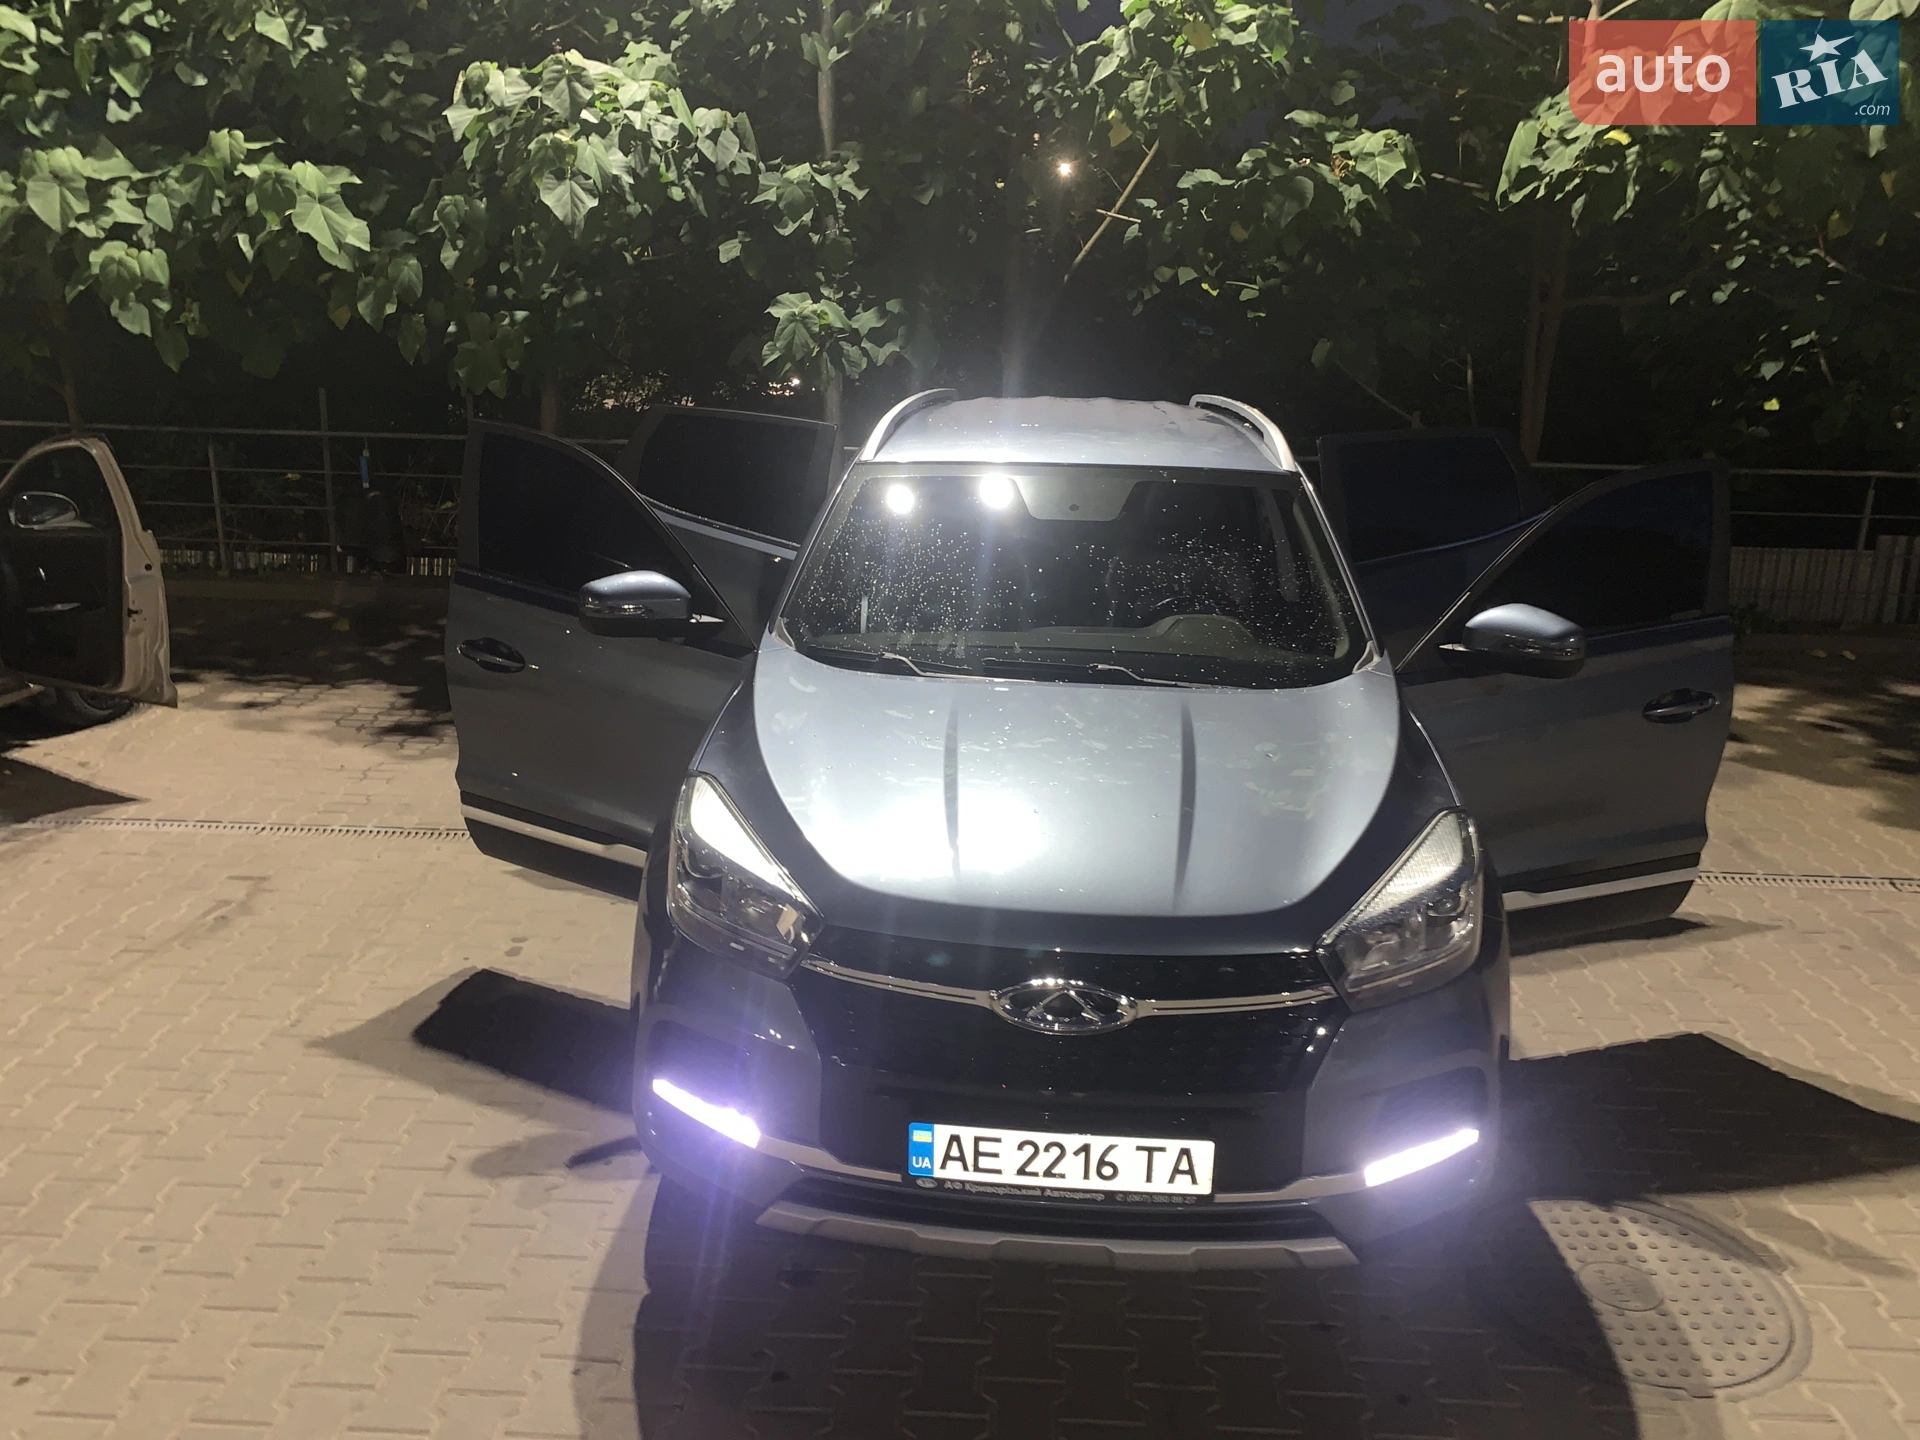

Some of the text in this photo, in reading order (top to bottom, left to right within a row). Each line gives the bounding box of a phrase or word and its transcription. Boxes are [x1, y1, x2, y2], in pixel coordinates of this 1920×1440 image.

[911, 1156, 932, 1169] UA
[939, 1133, 1198, 1186] AE 2216 TA
